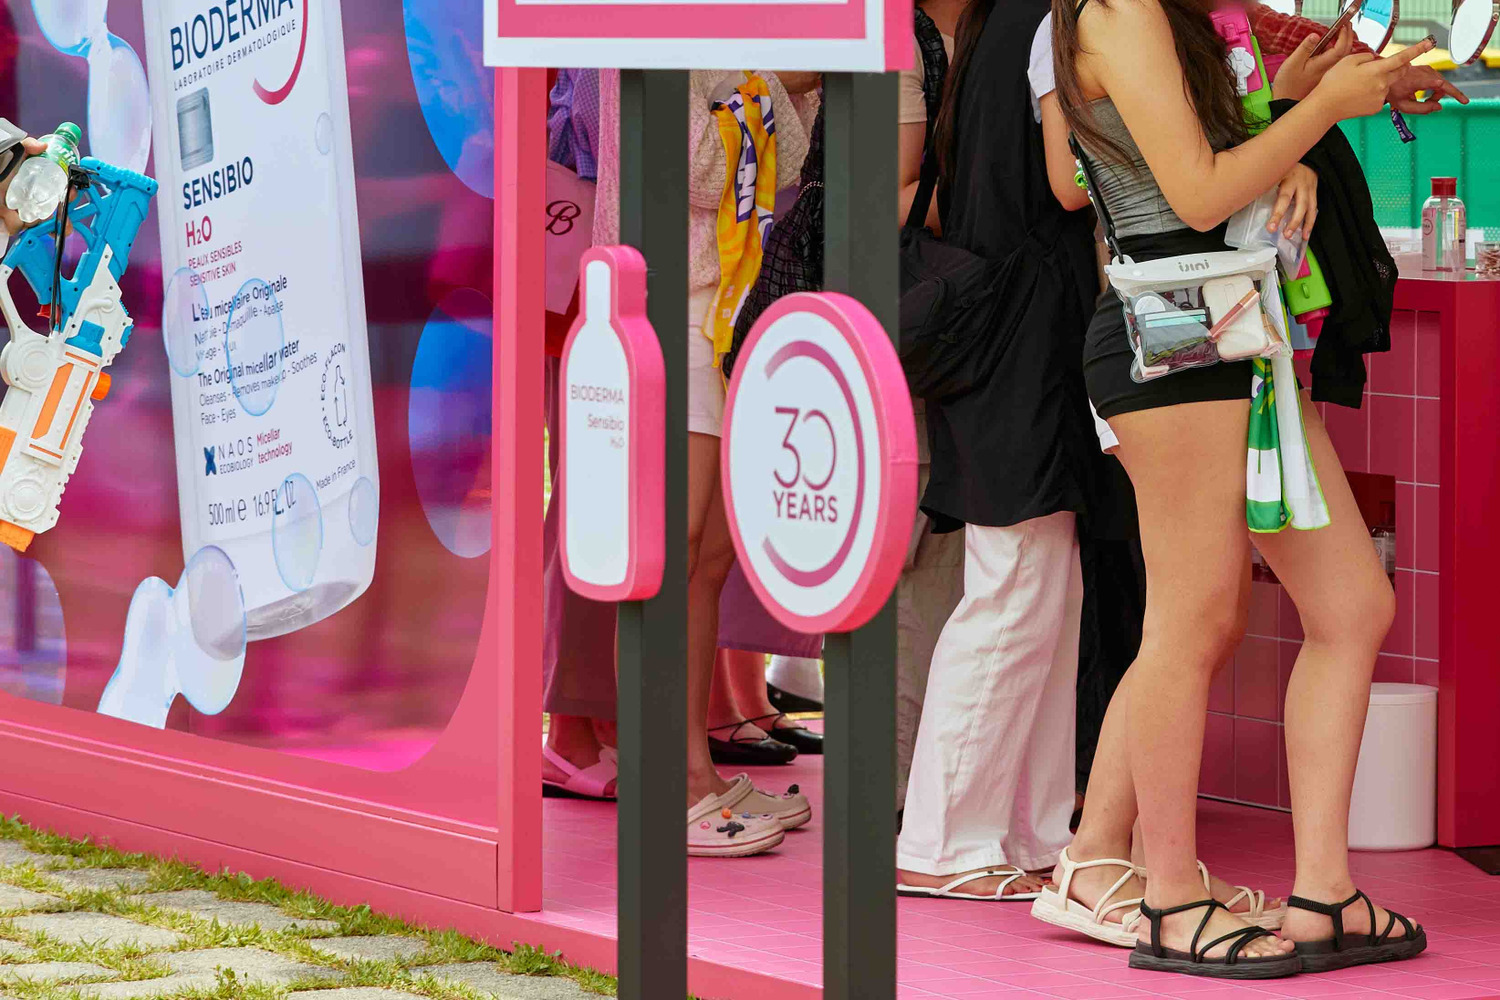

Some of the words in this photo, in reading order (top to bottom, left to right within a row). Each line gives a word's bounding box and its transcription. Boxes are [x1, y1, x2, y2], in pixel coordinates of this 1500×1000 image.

[174, 57, 224, 91] LABORATOIRE
[227, 19, 296, 65] DERMATOLOGIQUE
[183, 156, 253, 210] SENSIBIO
[188, 253, 209, 269] PEAUX
[210, 241, 242, 263] SENSIBLES
[190, 267, 221, 287] SENSITIVE
[222, 261, 236, 276] SKIN
[252, 274, 287, 300] Originale
[198, 371, 212, 388] The
[214, 362, 244, 385] Original
[246, 352, 278, 375] micellar
[279, 339, 299, 361] water
[200, 390, 227, 407] Cleanses
[292, 352, 318, 375] Soothes
[571, 384, 625, 405] BIODERMA
[201, 412, 216, 426] Face
[221, 408, 237, 423] Eyes
[587, 413, 625, 431] Sensibio
[218, 436, 253, 460] NAOS
[257, 428, 281, 447] Micellar
[773, 406, 837, 491] 30
[220, 457, 254, 475] ECOBIOLOGY
[258, 441, 293, 465] technology
[315, 475, 331, 491] Made
[332, 470, 337, 481] in
[337, 459, 356, 478] France
[772, 490, 838, 523] YEARS
